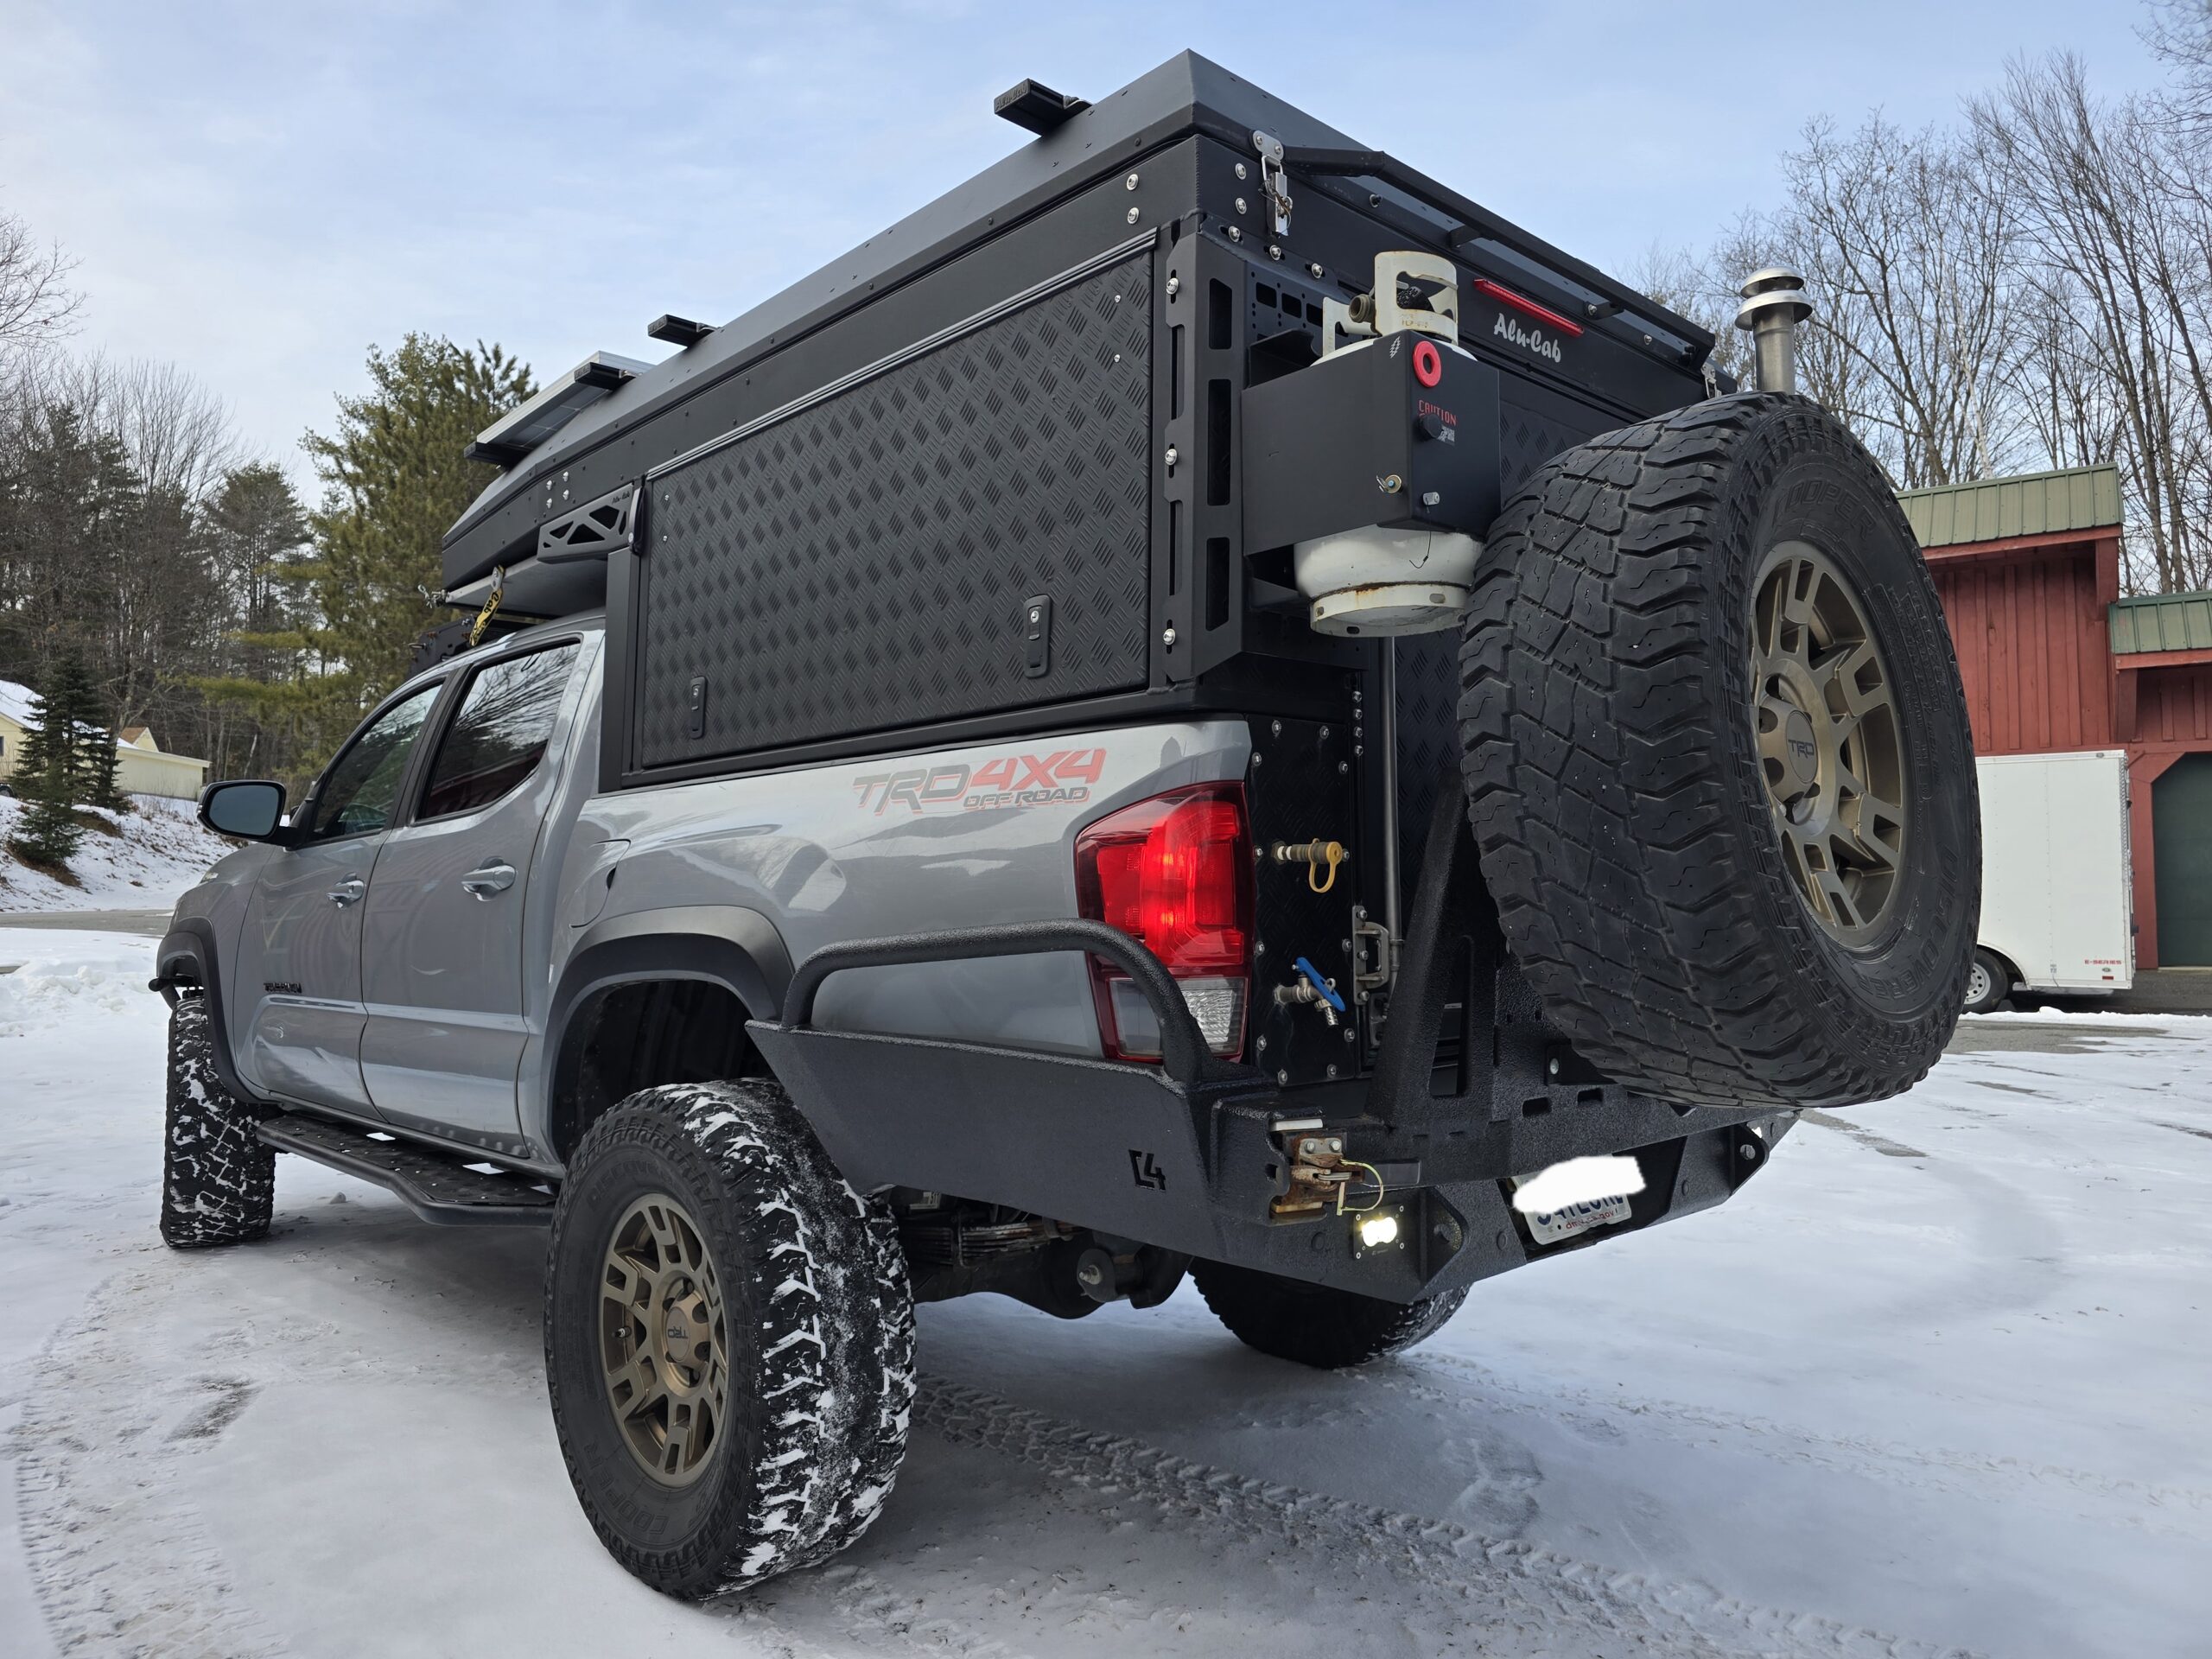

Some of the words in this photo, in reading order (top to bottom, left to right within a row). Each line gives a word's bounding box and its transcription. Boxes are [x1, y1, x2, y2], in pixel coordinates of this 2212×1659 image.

[1494, 313, 1561, 363] Alu-Cab
[1419, 399, 1456, 427] CAUTION
[1788, 739, 1815, 760] TRD
[852, 764, 970, 817] TRD
[963, 791, 1013, 810] OFF
[1014, 786, 1090, 806] ROAD
[1566, 1211, 1614, 1230] dmv.ca.gov
